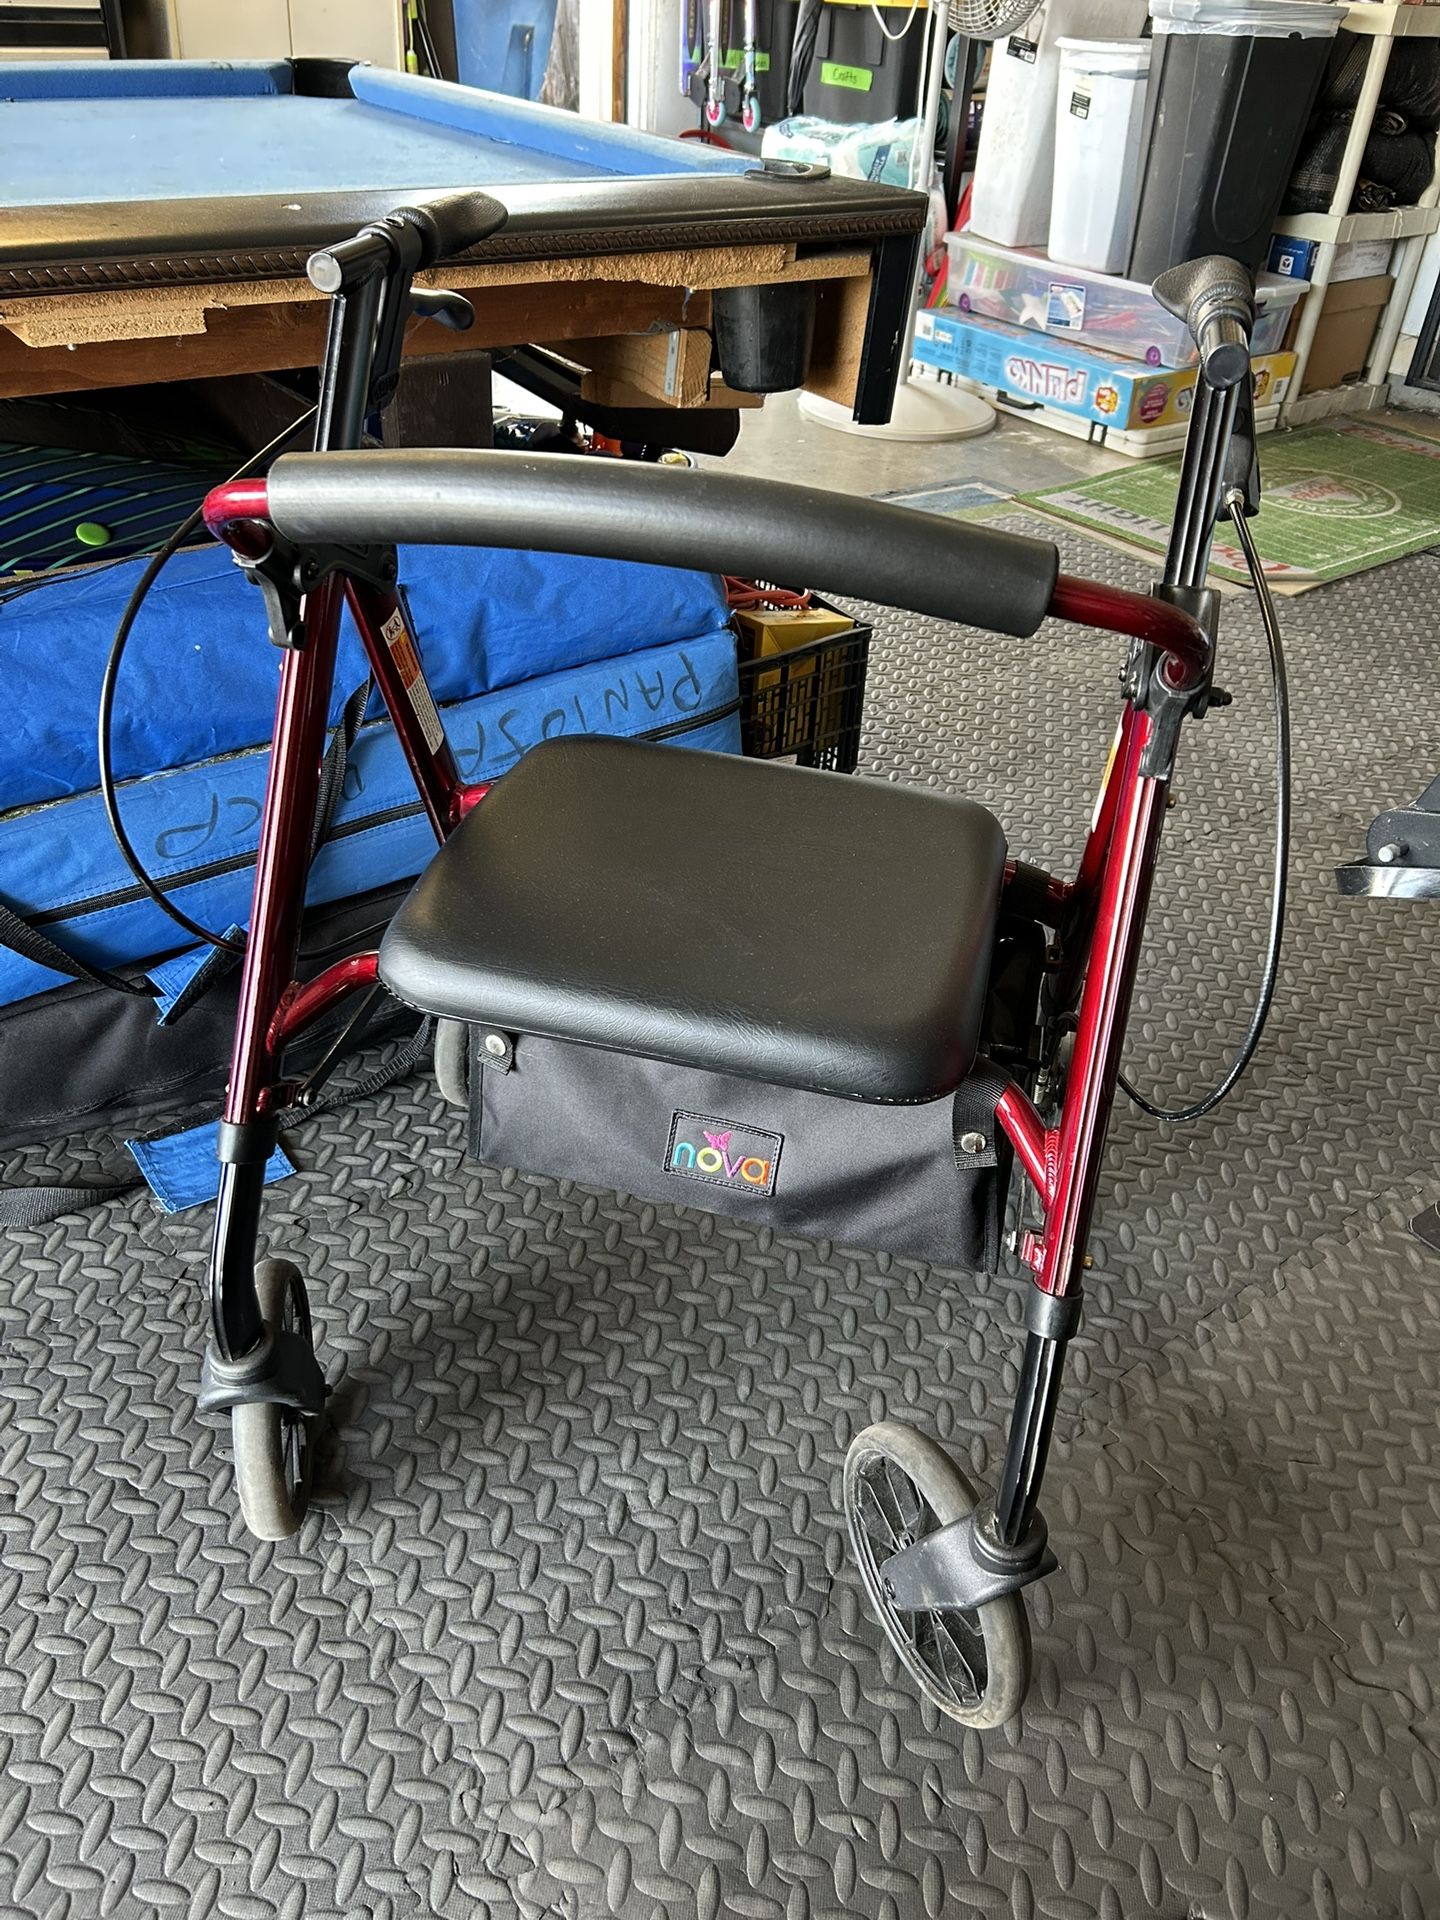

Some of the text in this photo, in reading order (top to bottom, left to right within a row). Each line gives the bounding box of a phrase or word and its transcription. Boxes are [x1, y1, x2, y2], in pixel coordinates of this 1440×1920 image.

[831, 67, 858, 85] Crafts
[1006, 356, 1087, 403] PLINKO
[1063, 497, 1170, 531] LIGHT
[673, 1141, 769, 1185] nova
